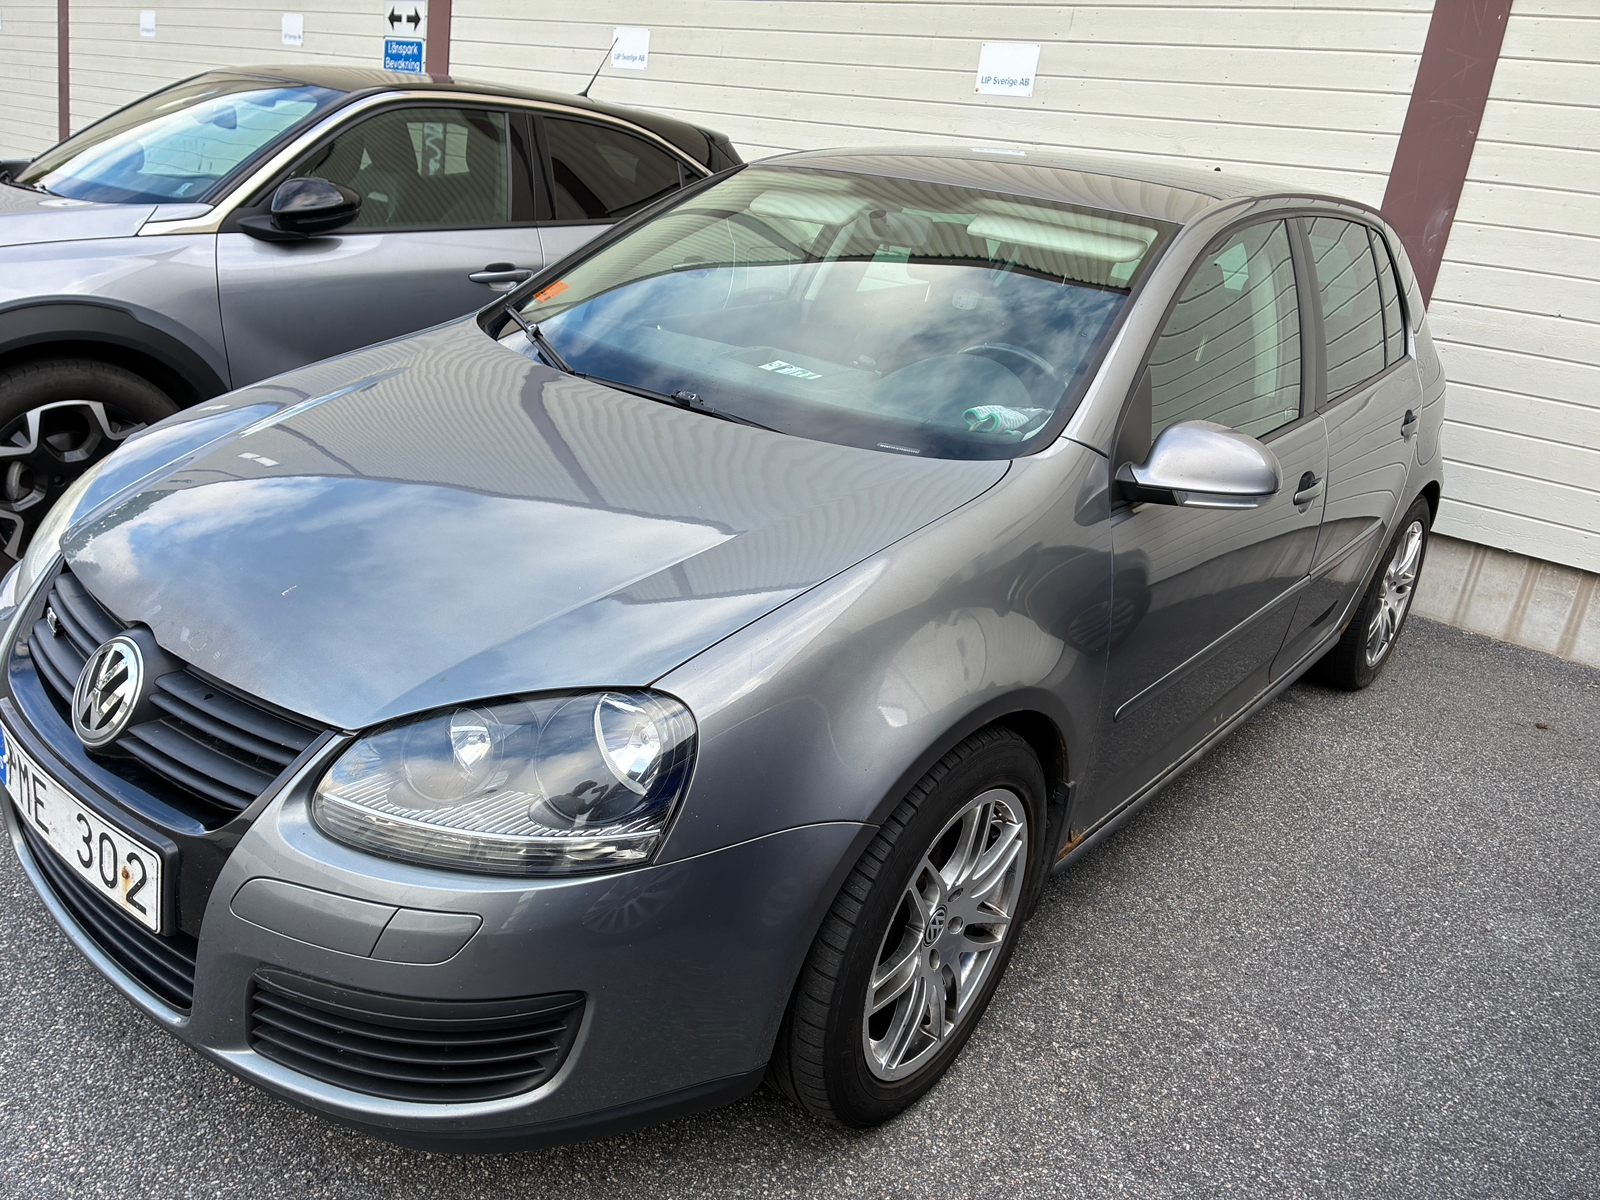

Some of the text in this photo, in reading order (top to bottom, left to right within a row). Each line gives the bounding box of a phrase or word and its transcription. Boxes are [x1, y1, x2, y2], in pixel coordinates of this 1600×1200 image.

[388, 42, 418, 57] Länspark
[385, 56, 420, 72] Bevakning
[981, 75, 1030, 87] LIP Sverige AB
[76, 812, 148, 916] 302
